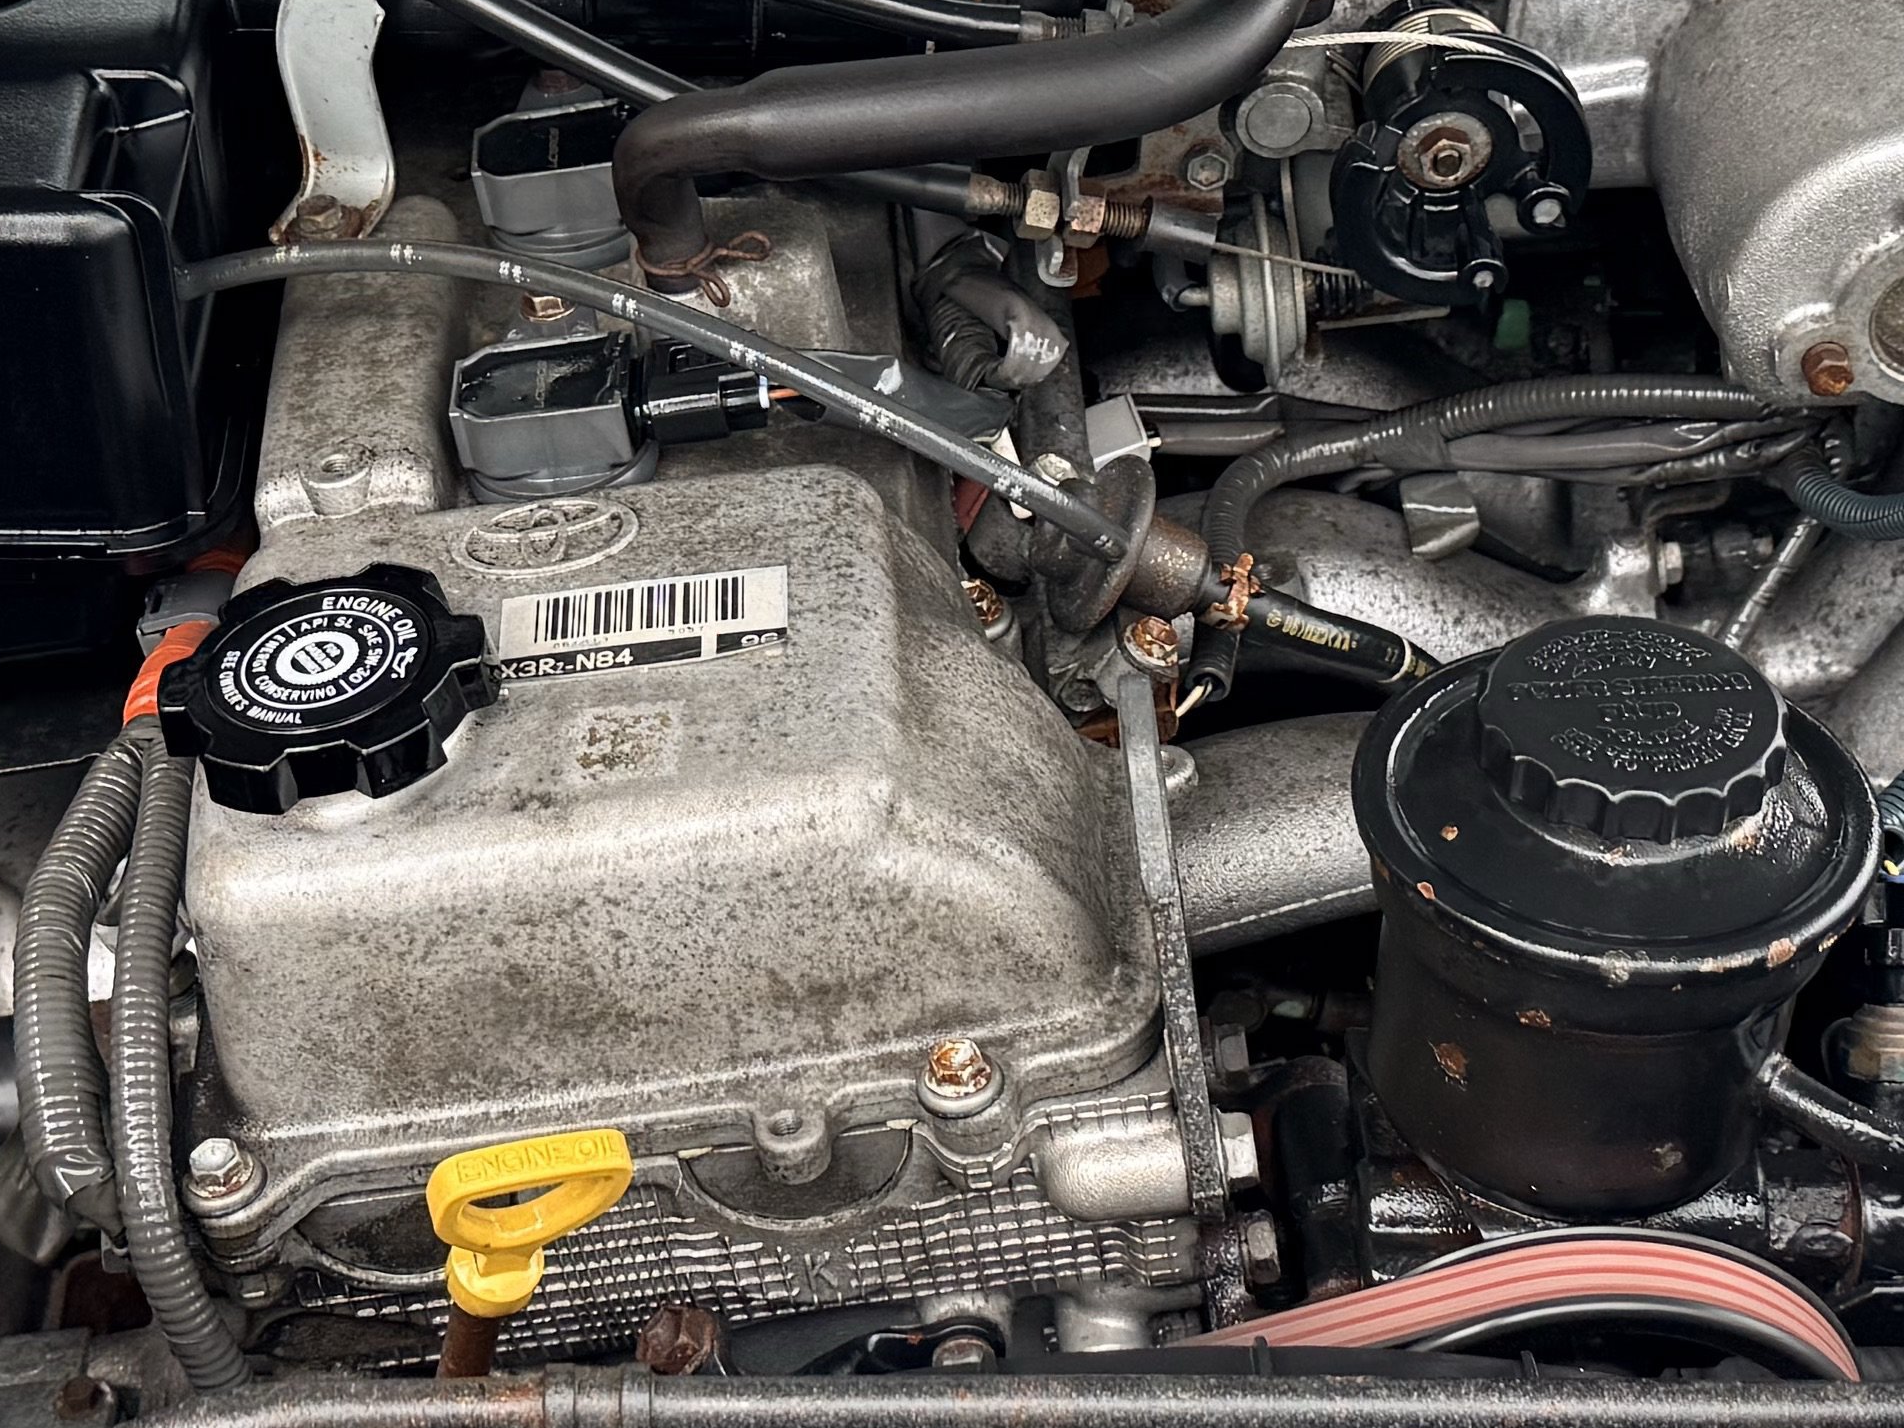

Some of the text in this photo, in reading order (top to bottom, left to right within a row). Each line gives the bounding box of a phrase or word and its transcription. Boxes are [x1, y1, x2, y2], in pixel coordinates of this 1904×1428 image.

[300, 617, 328, 633] API
[334, 616, 354, 629] SL
[357, 624, 383, 647] SAE
[322, 596, 419, 646] ENGINE OIL
[220, 650, 241, 670] SEE
[246, 705, 303, 724] MANUAL
[254, 675, 337, 702] CONSERVING
[456, 1134, 624, 1184] ENGINE OIL
